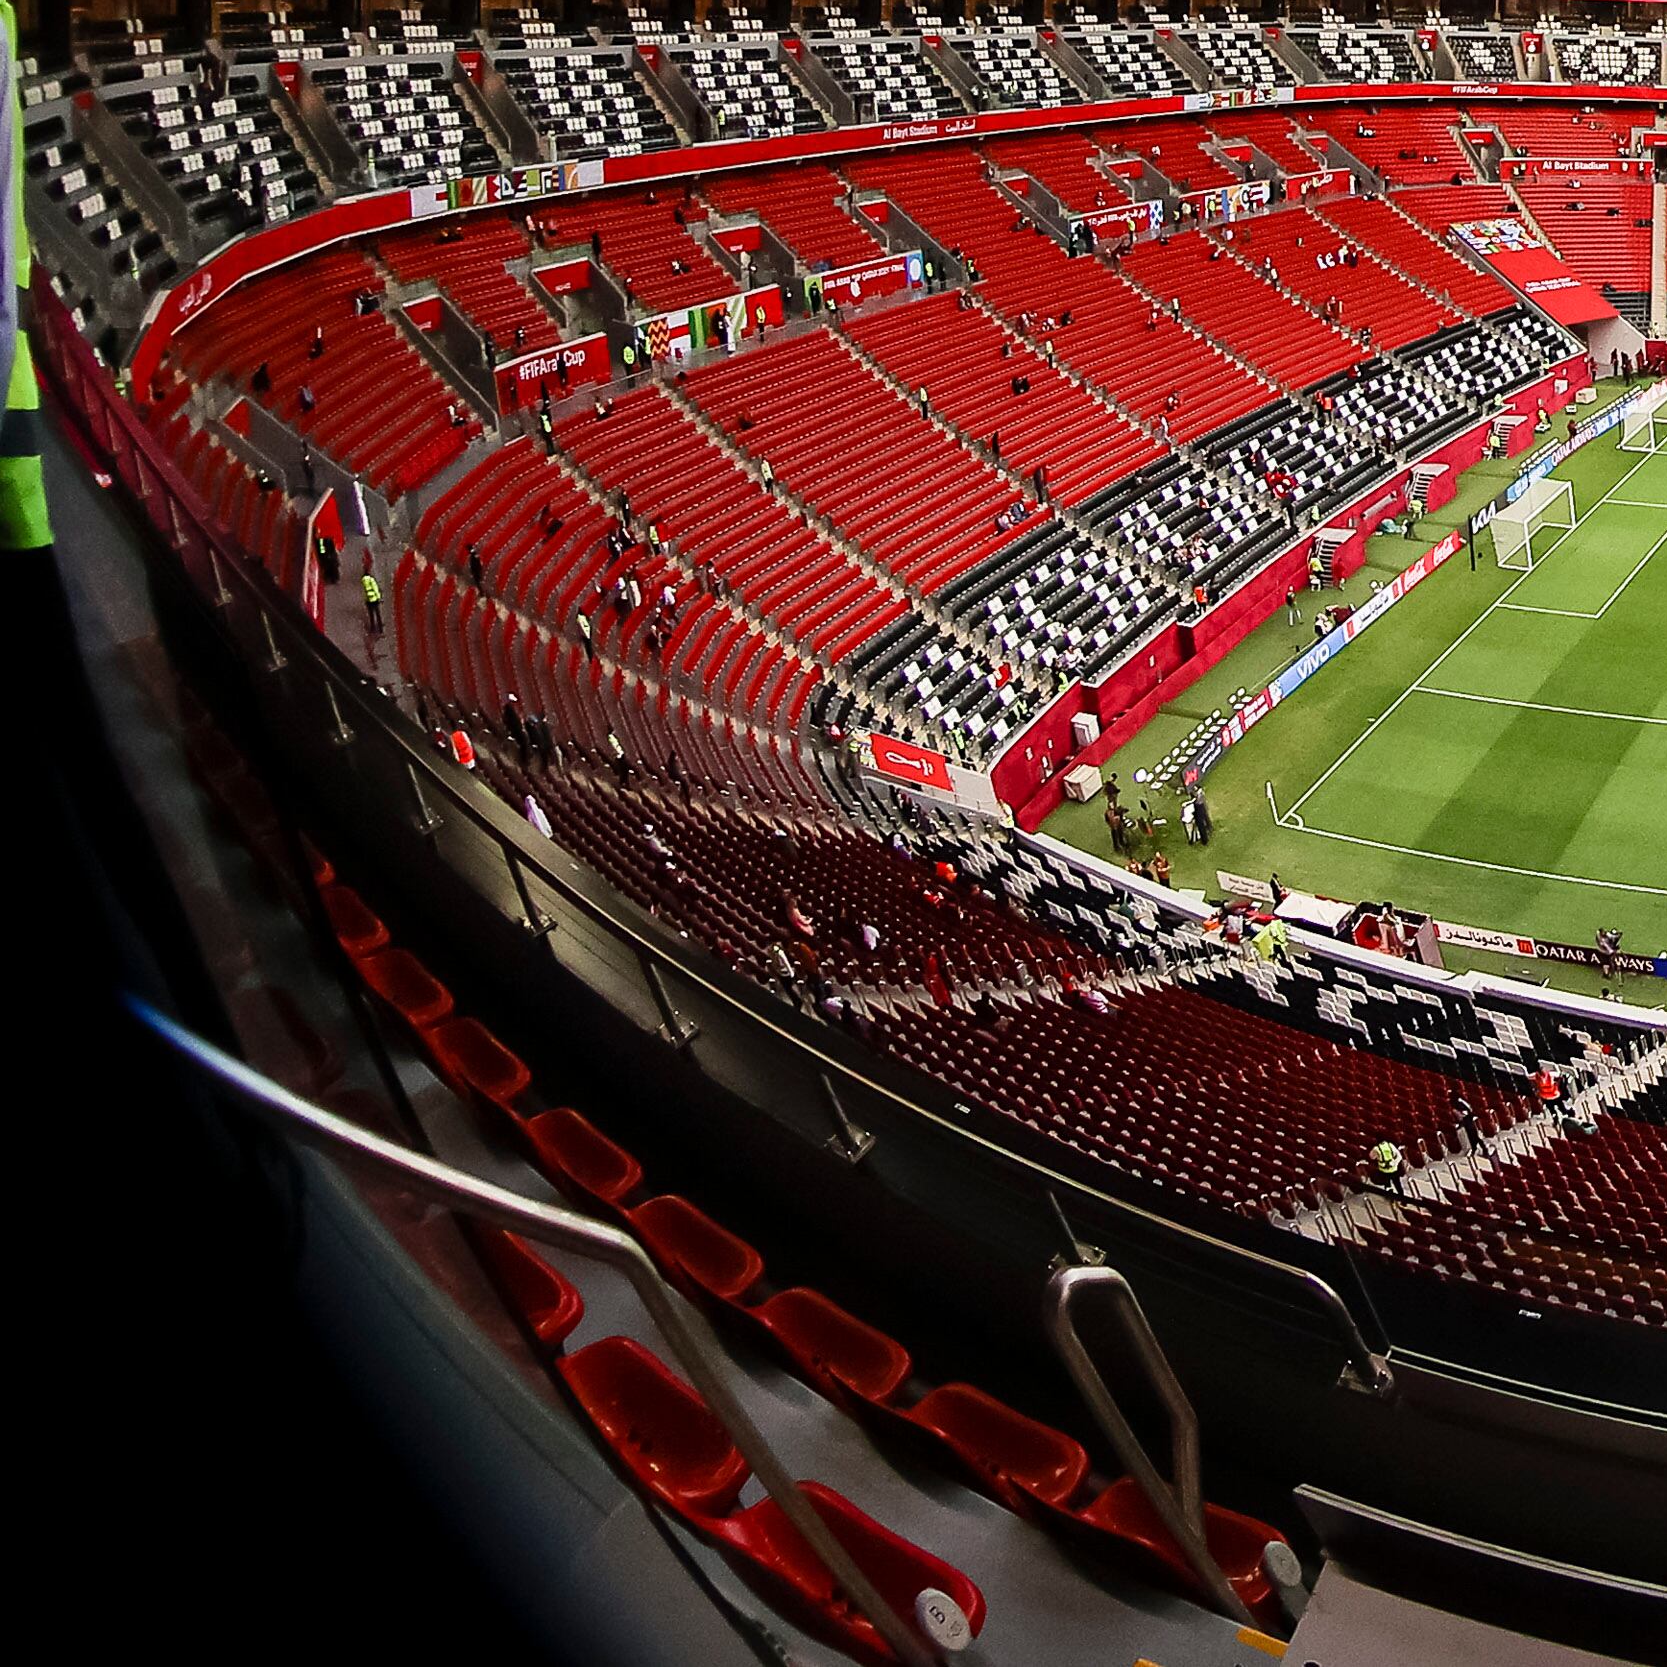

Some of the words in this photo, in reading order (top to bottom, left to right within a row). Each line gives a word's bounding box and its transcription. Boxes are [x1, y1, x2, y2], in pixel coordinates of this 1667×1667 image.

[884, 128, 893, 140] Al
[893, 126, 909, 138] Bayt
[909, 124, 938, 137] Stadium
[1542, 161, 1553, 170] Al
[1554, 161, 1573, 172] Bayt
[1574, 160, 1610, 170] Stadium
[519, 350, 586, 380] #FIFAraCup
[1471, 500, 1498, 535] KIA
[1444, 922, 1513, 949] ماكدونالدز
[1588, 951, 1655, 973] AWAYS
